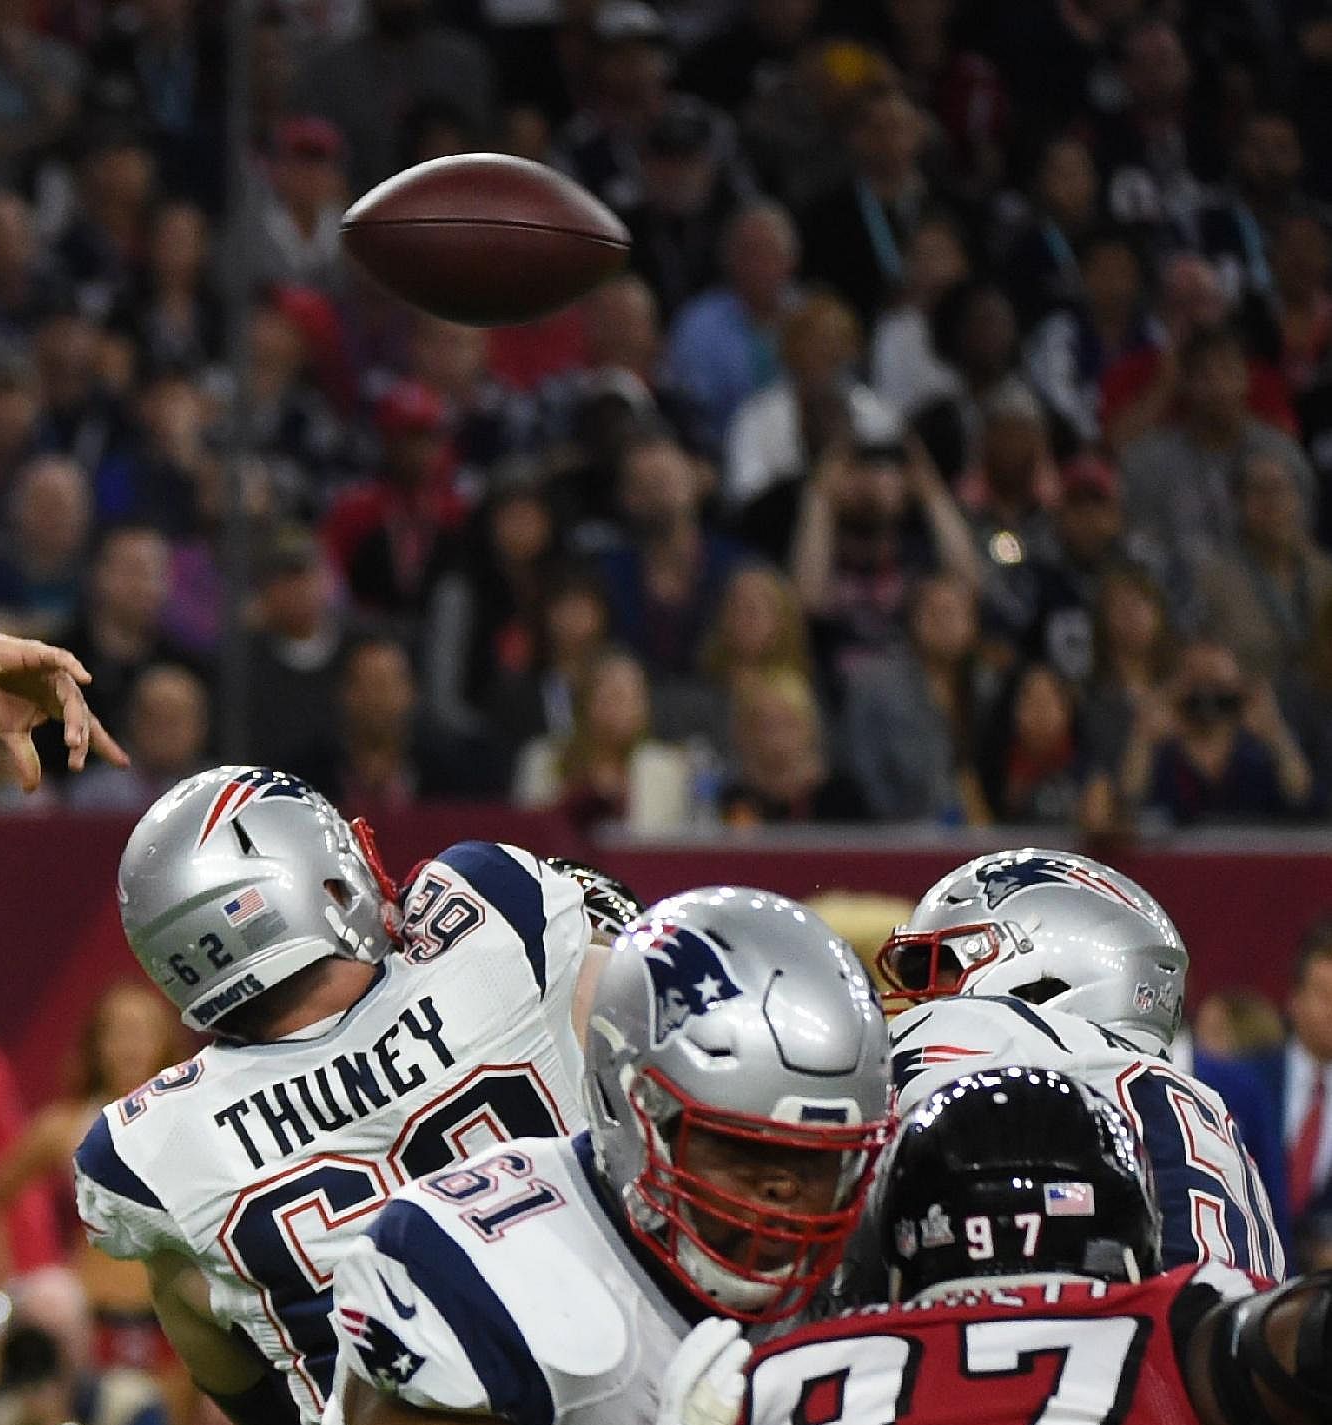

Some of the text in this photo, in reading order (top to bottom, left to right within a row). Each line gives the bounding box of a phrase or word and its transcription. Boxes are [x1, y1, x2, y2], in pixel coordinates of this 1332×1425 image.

[169, 932, 234, 986] 62
[213, 995, 456, 1170] THUNEY
[418, 1148, 567, 1244] 61
[963, 1211, 1042, 1262] 97
